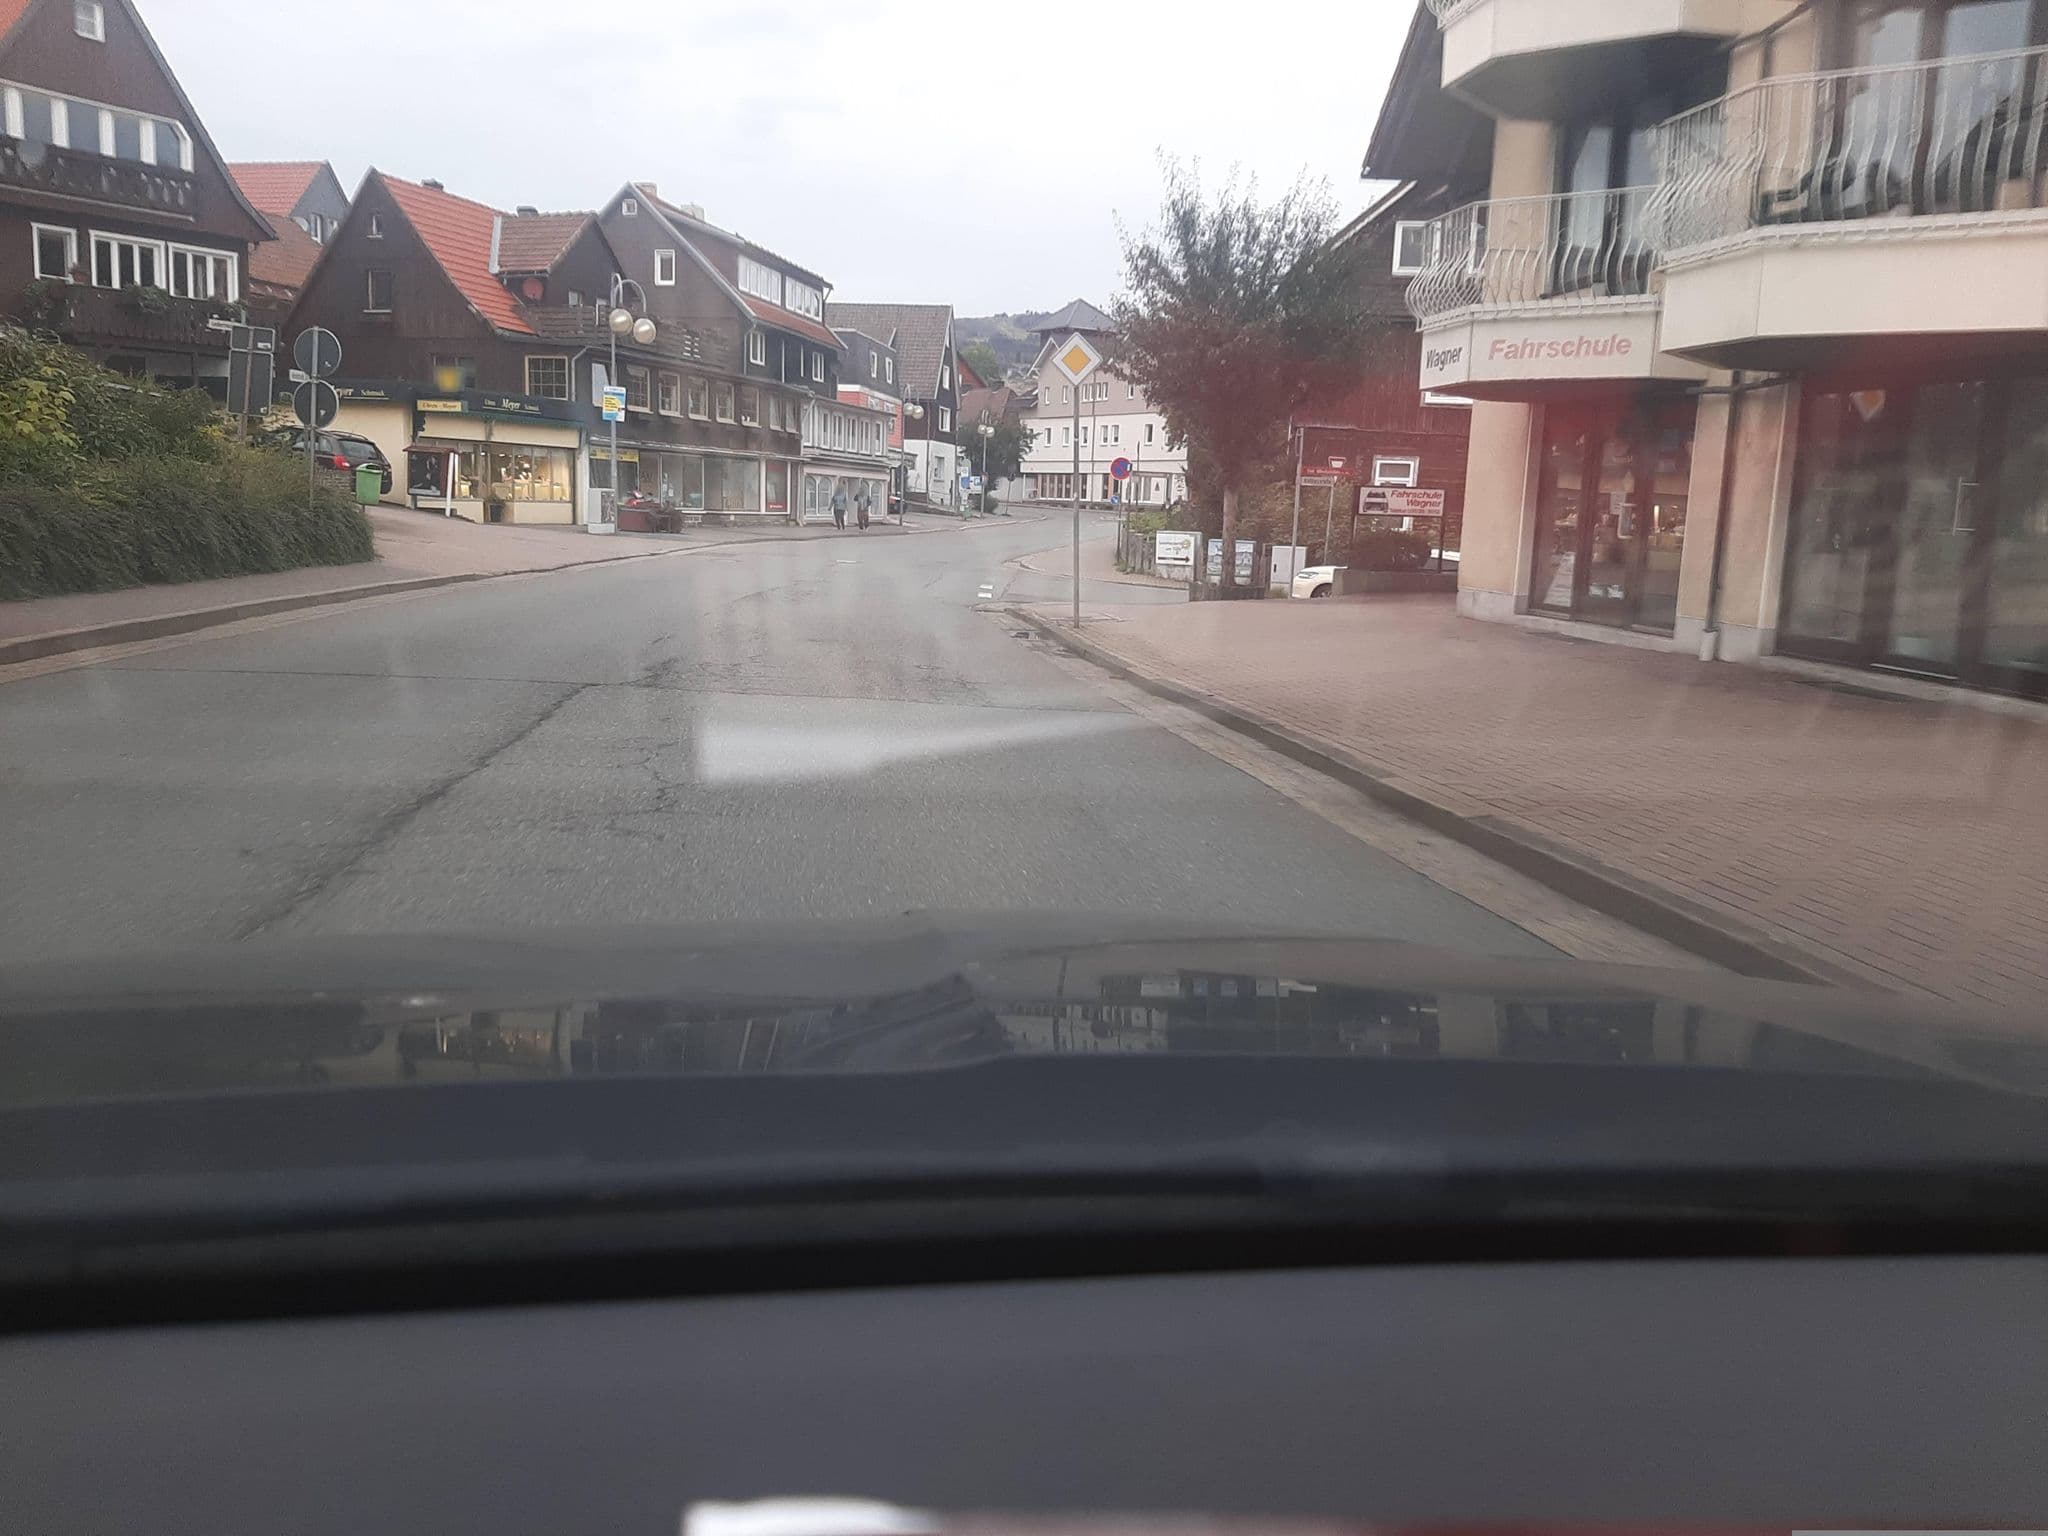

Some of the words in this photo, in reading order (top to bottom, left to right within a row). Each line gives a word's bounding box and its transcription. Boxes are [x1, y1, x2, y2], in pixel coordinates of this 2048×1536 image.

[1488, 333, 1632, 361] Fahrschule
[1425, 346, 1463, 371] Wagner
[1390, 490, 1442, 499] Fahrschule
[1406, 499, 1441, 508] Wagner
